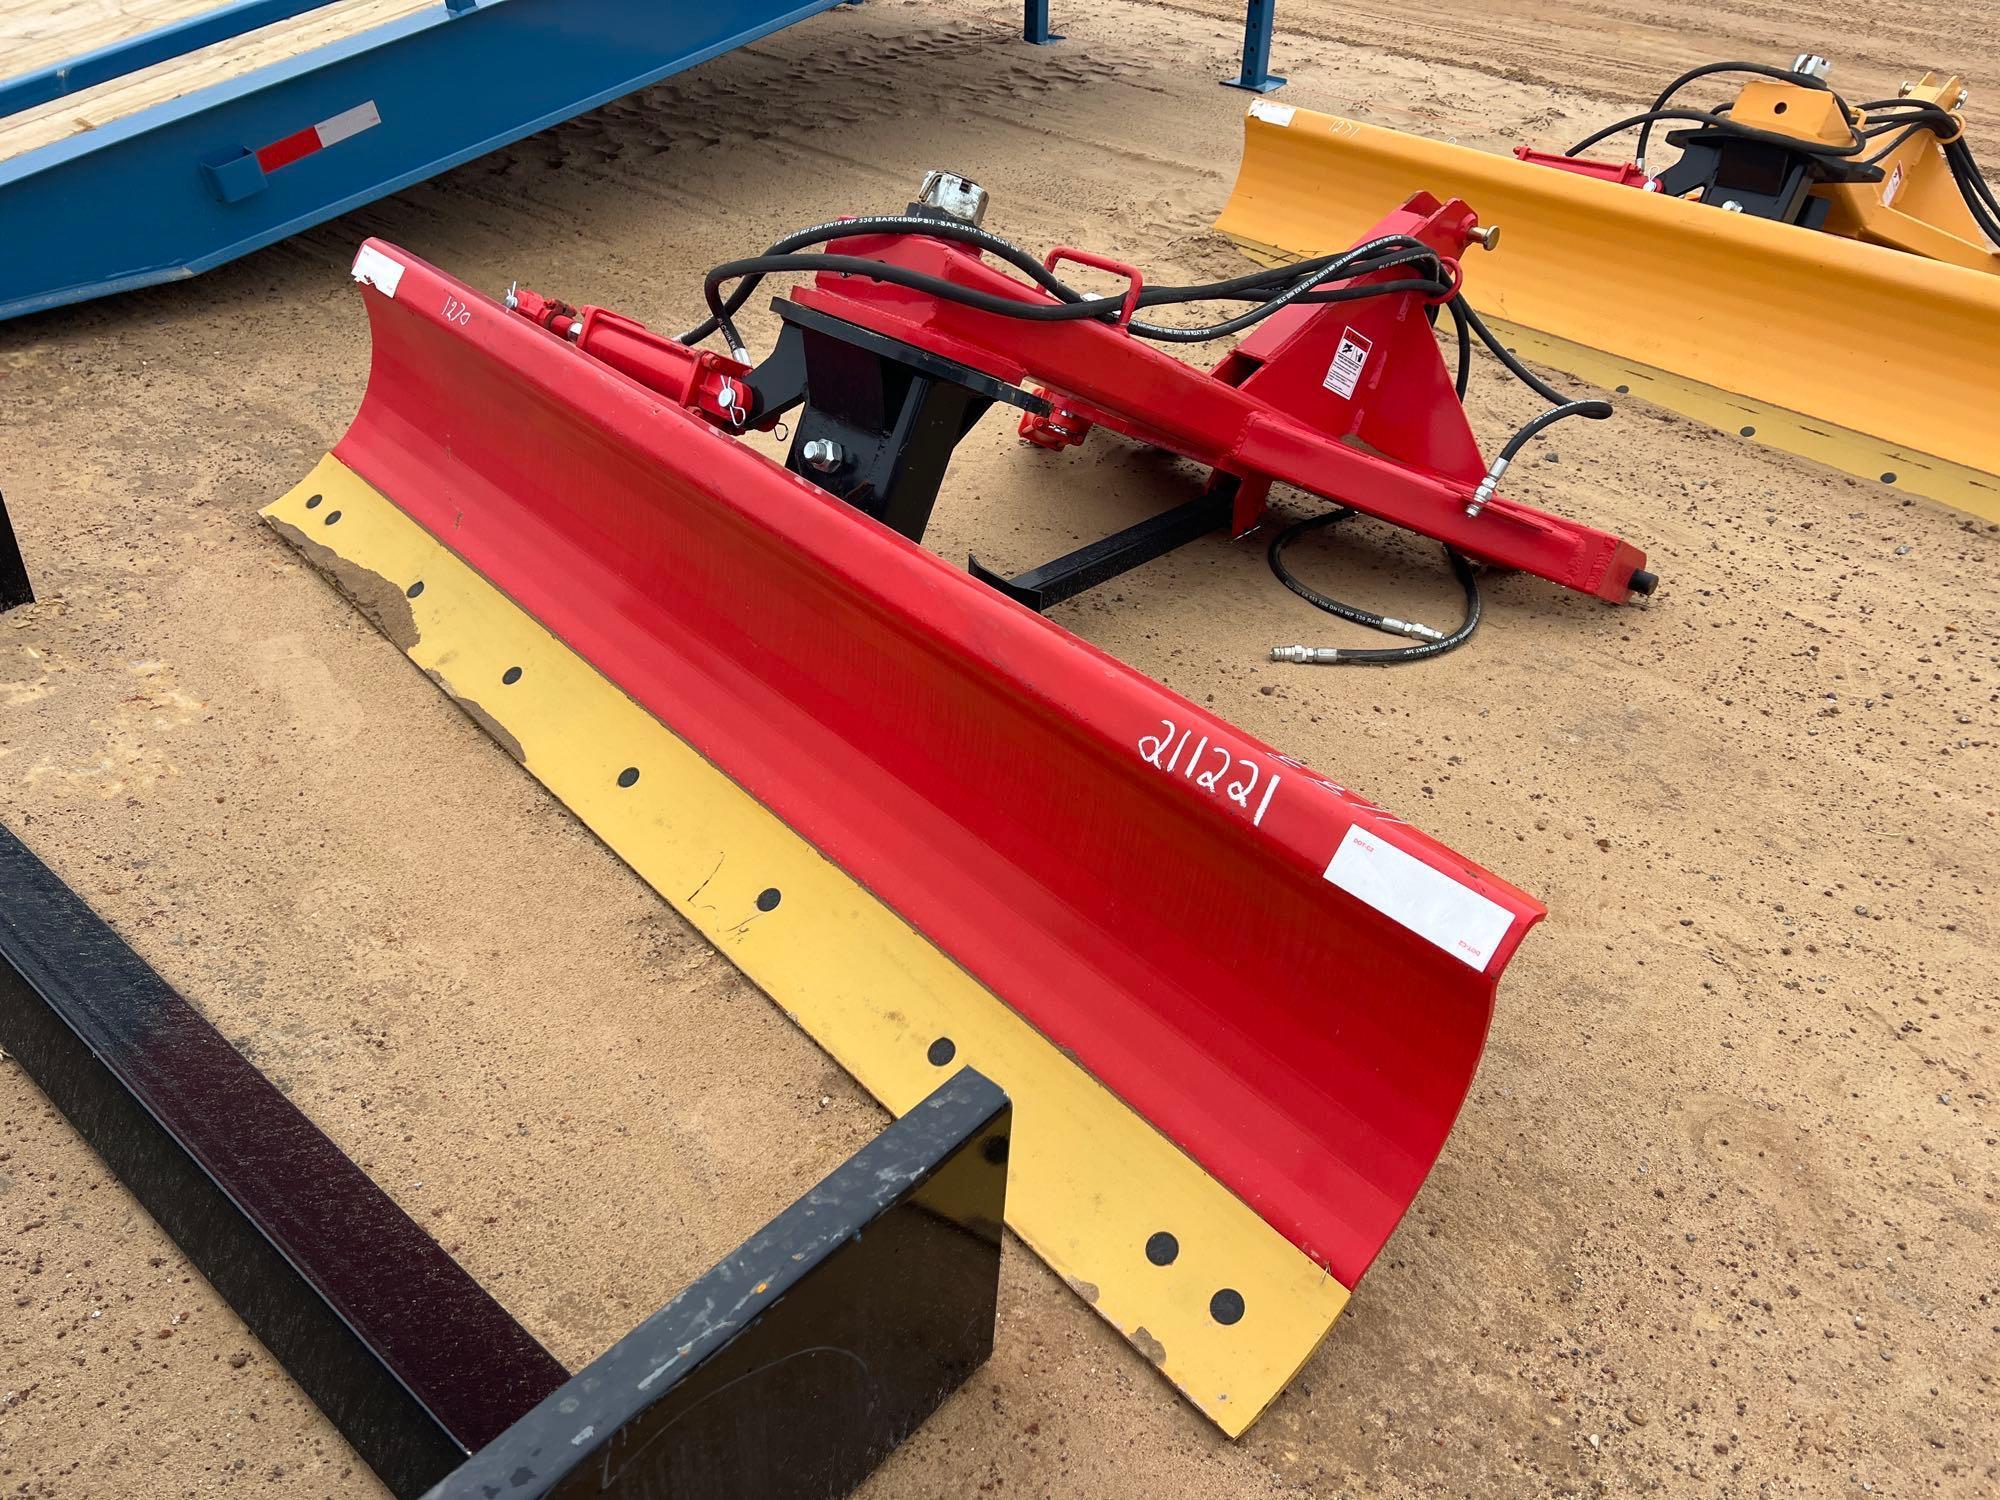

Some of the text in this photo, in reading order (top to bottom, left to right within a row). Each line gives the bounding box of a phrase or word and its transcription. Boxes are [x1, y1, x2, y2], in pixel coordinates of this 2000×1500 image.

[843, 217, 857, 225] WP
[1137, 719, 1281, 828] 211221
[1352, 837, 1376, 854] DOT-C2
[1457, 939, 1482, 957] DOT-C2
